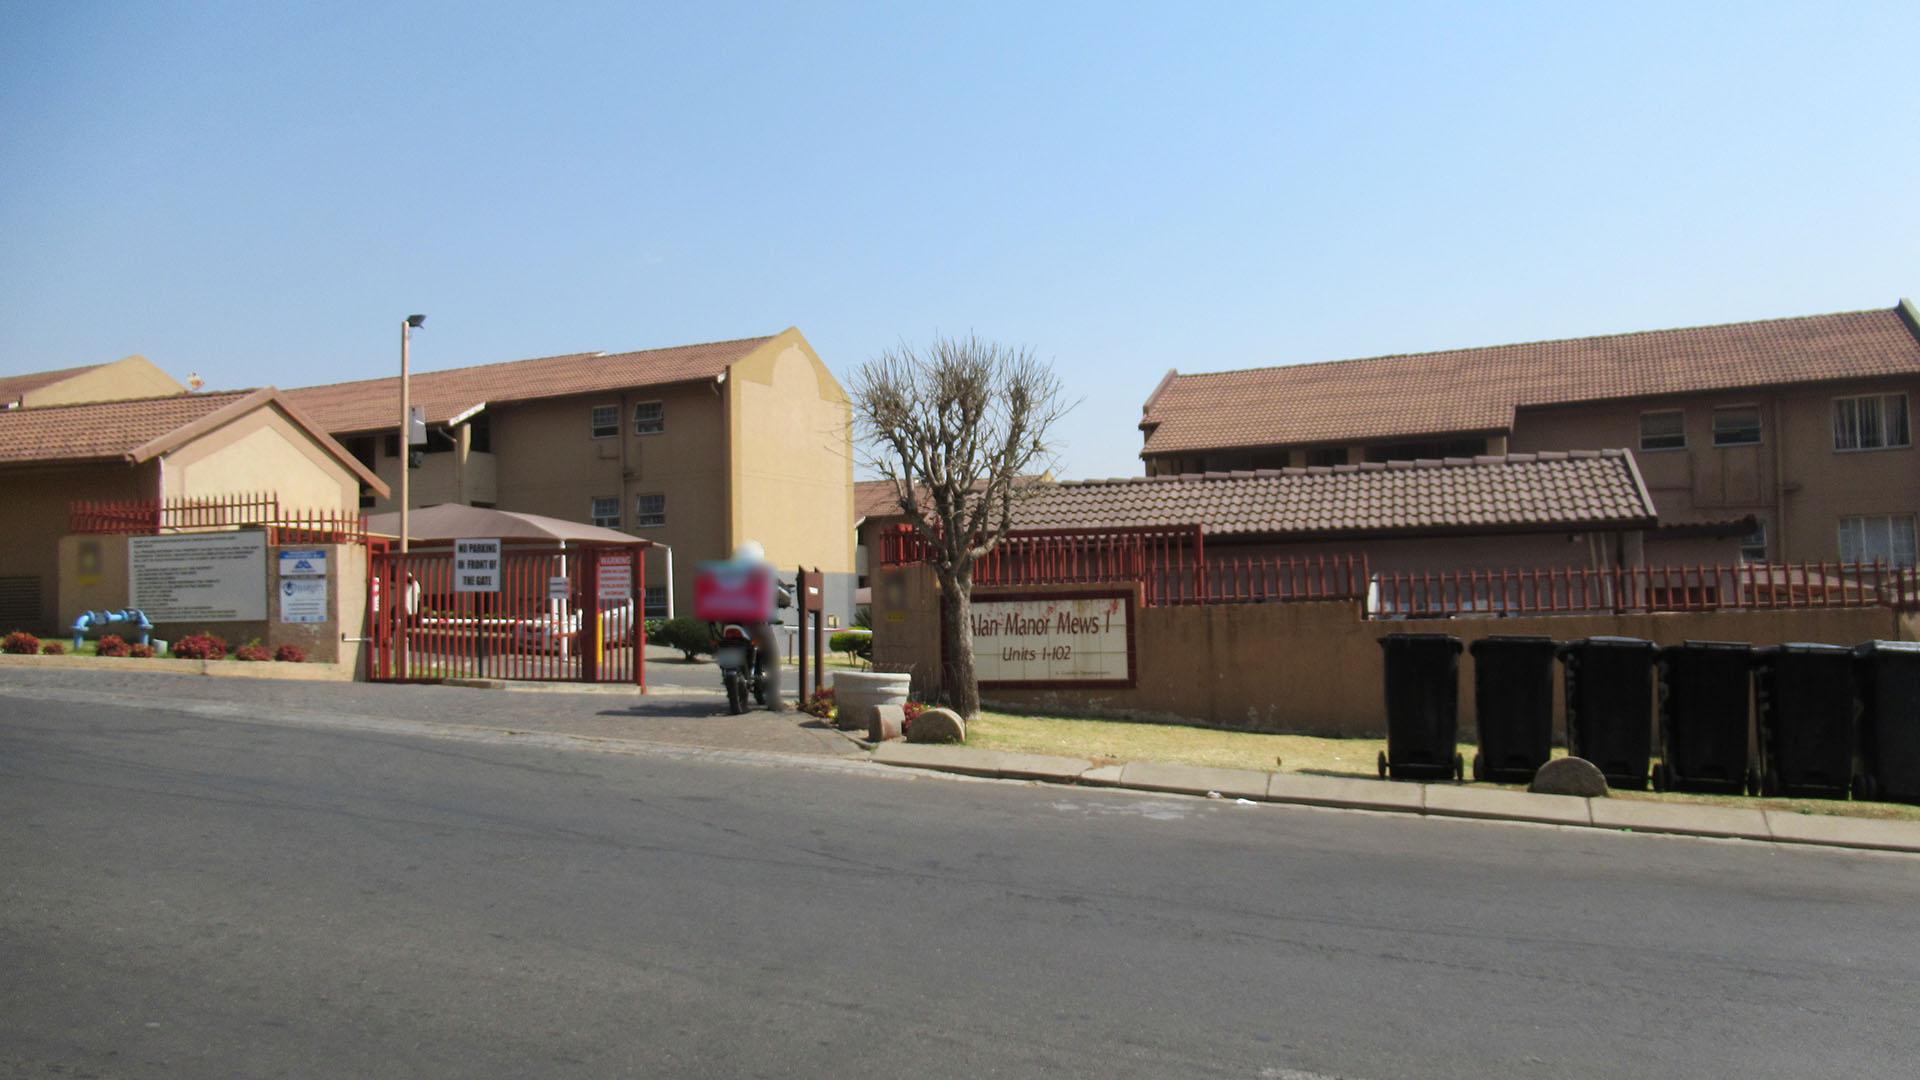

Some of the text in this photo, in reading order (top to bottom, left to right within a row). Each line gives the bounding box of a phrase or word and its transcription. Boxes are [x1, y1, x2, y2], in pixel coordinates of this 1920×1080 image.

[458, 543, 497, 553] NO PARKING
[458, 559, 497, 570] IN FRONT OF
[463, 575, 492, 586] THE GATE
[1004, 612, 1051, 636] Manor
[1057, 611, 1099, 635] Mews
[1002, 645, 1071, 662] Units 1-102
